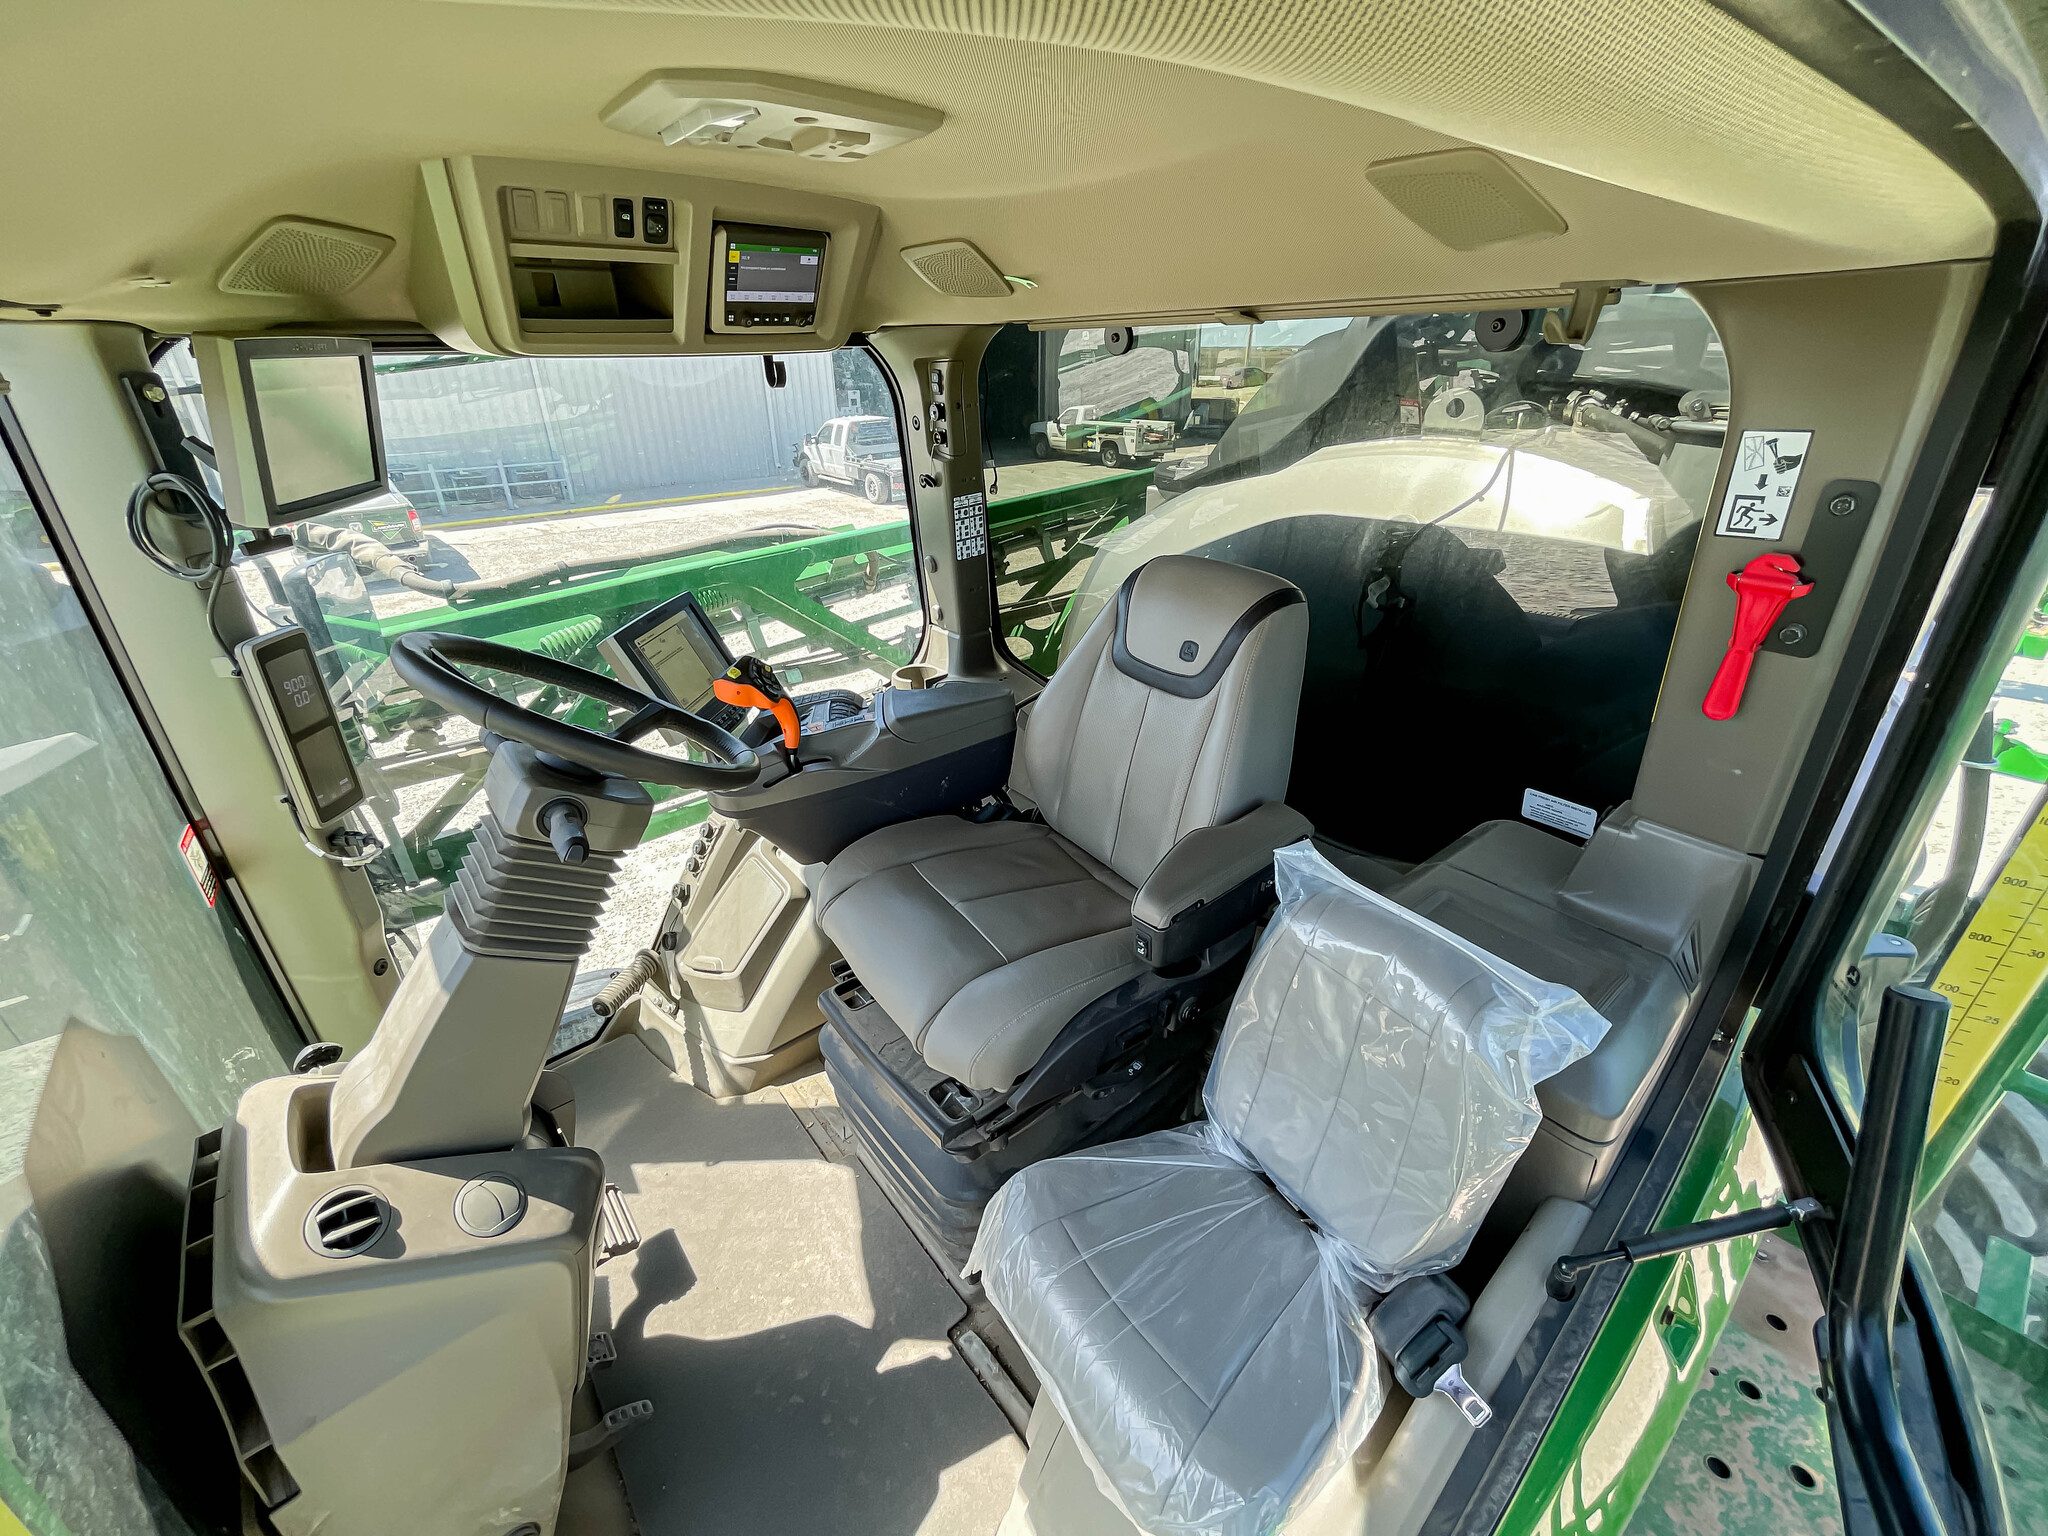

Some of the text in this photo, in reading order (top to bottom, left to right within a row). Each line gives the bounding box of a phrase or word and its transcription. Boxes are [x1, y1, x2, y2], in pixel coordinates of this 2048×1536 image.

[2002, 876, 2028, 888] 900
[1968, 931, 1992, 943] 800
[2027, 949, 2046, 959] 30
[1938, 982, 1960, 993] 700
[1983, 1015, 2000, 1025] 25
[1944, 1076, 1960, 1086] 20
